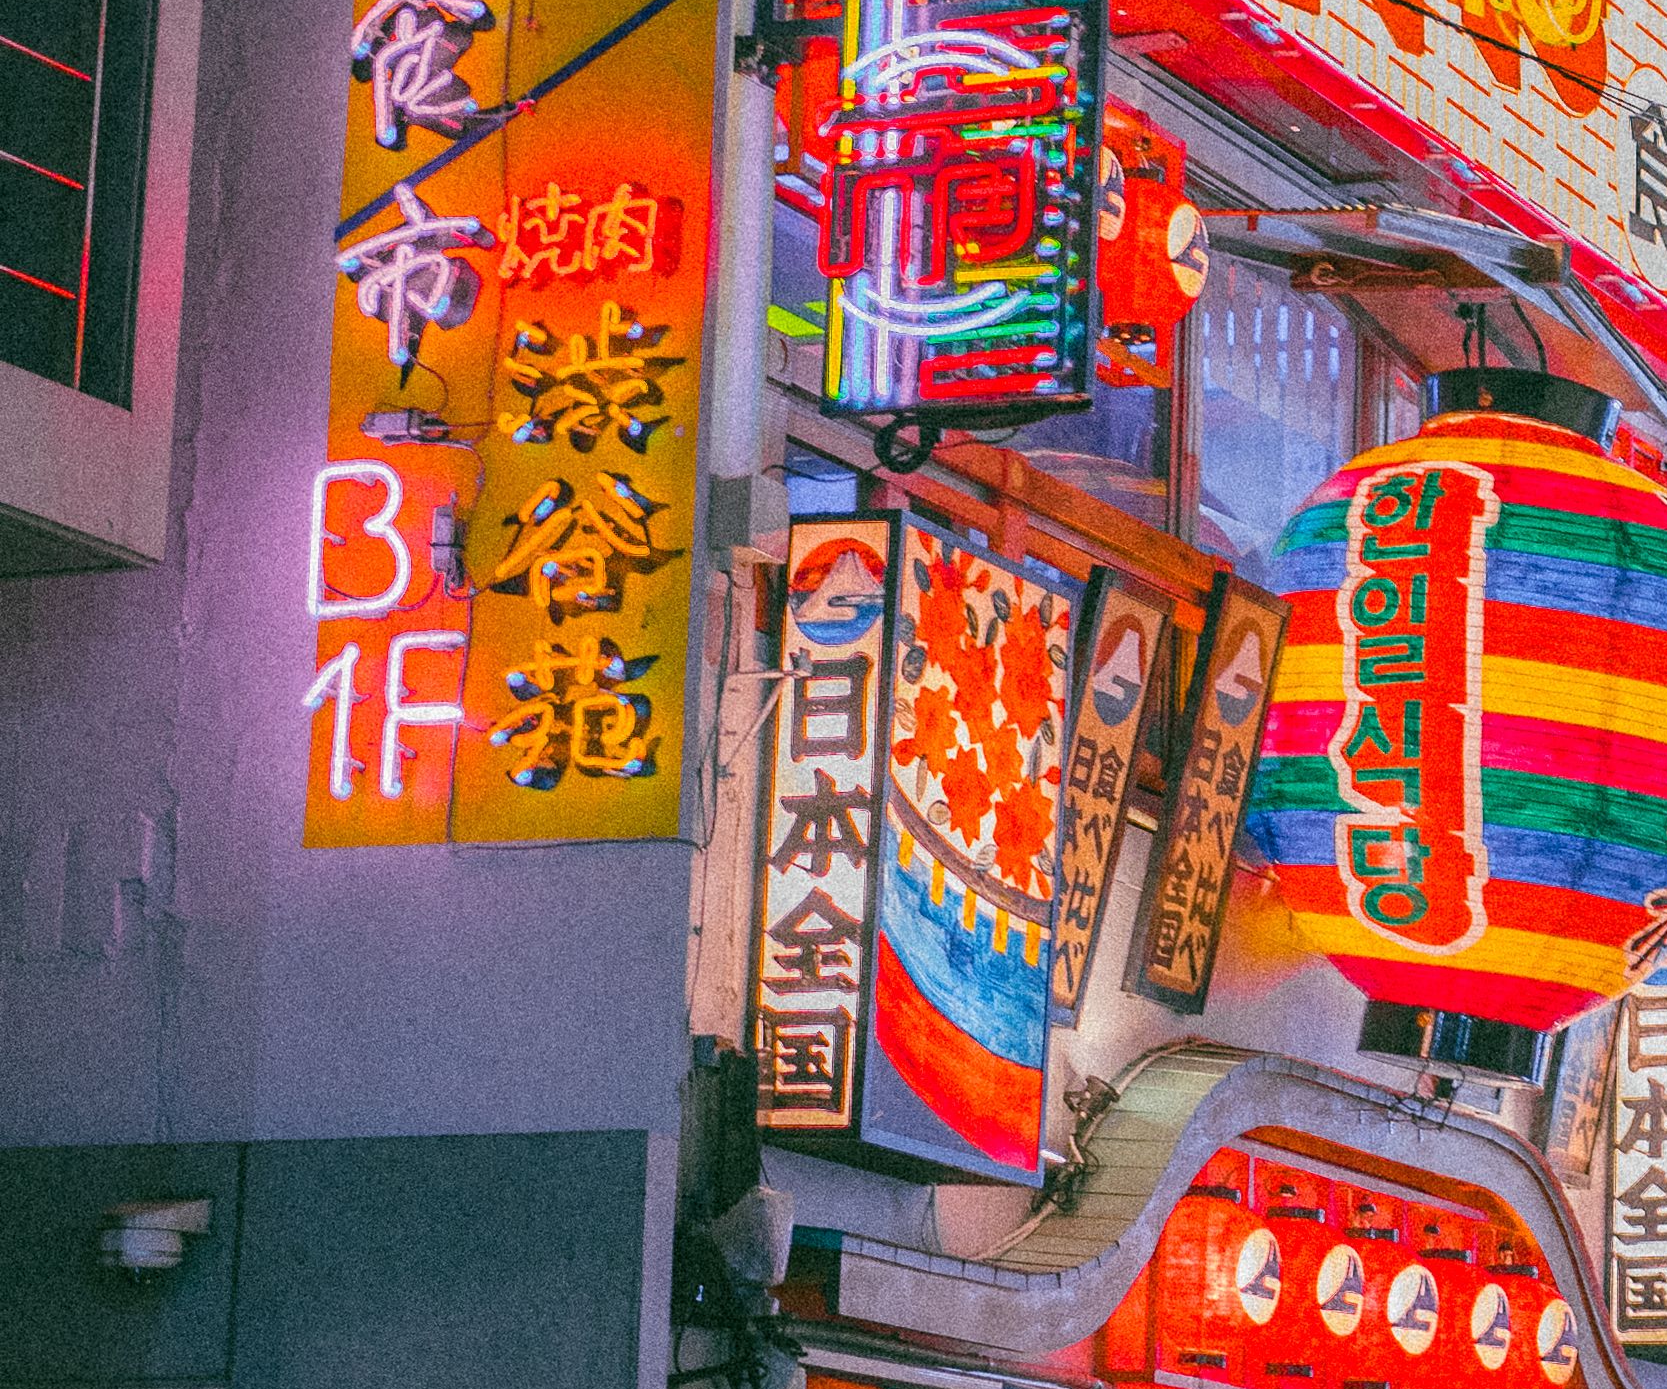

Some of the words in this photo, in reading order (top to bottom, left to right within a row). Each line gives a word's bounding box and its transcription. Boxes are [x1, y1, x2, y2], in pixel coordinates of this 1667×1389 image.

[499, 182, 657, 279] 焼肉
[489, 301, 650, 786] 渋谷苑
[1346, 471, 1453, 927] 한일식당
[768, 647, 873, 1109] 日本全国
